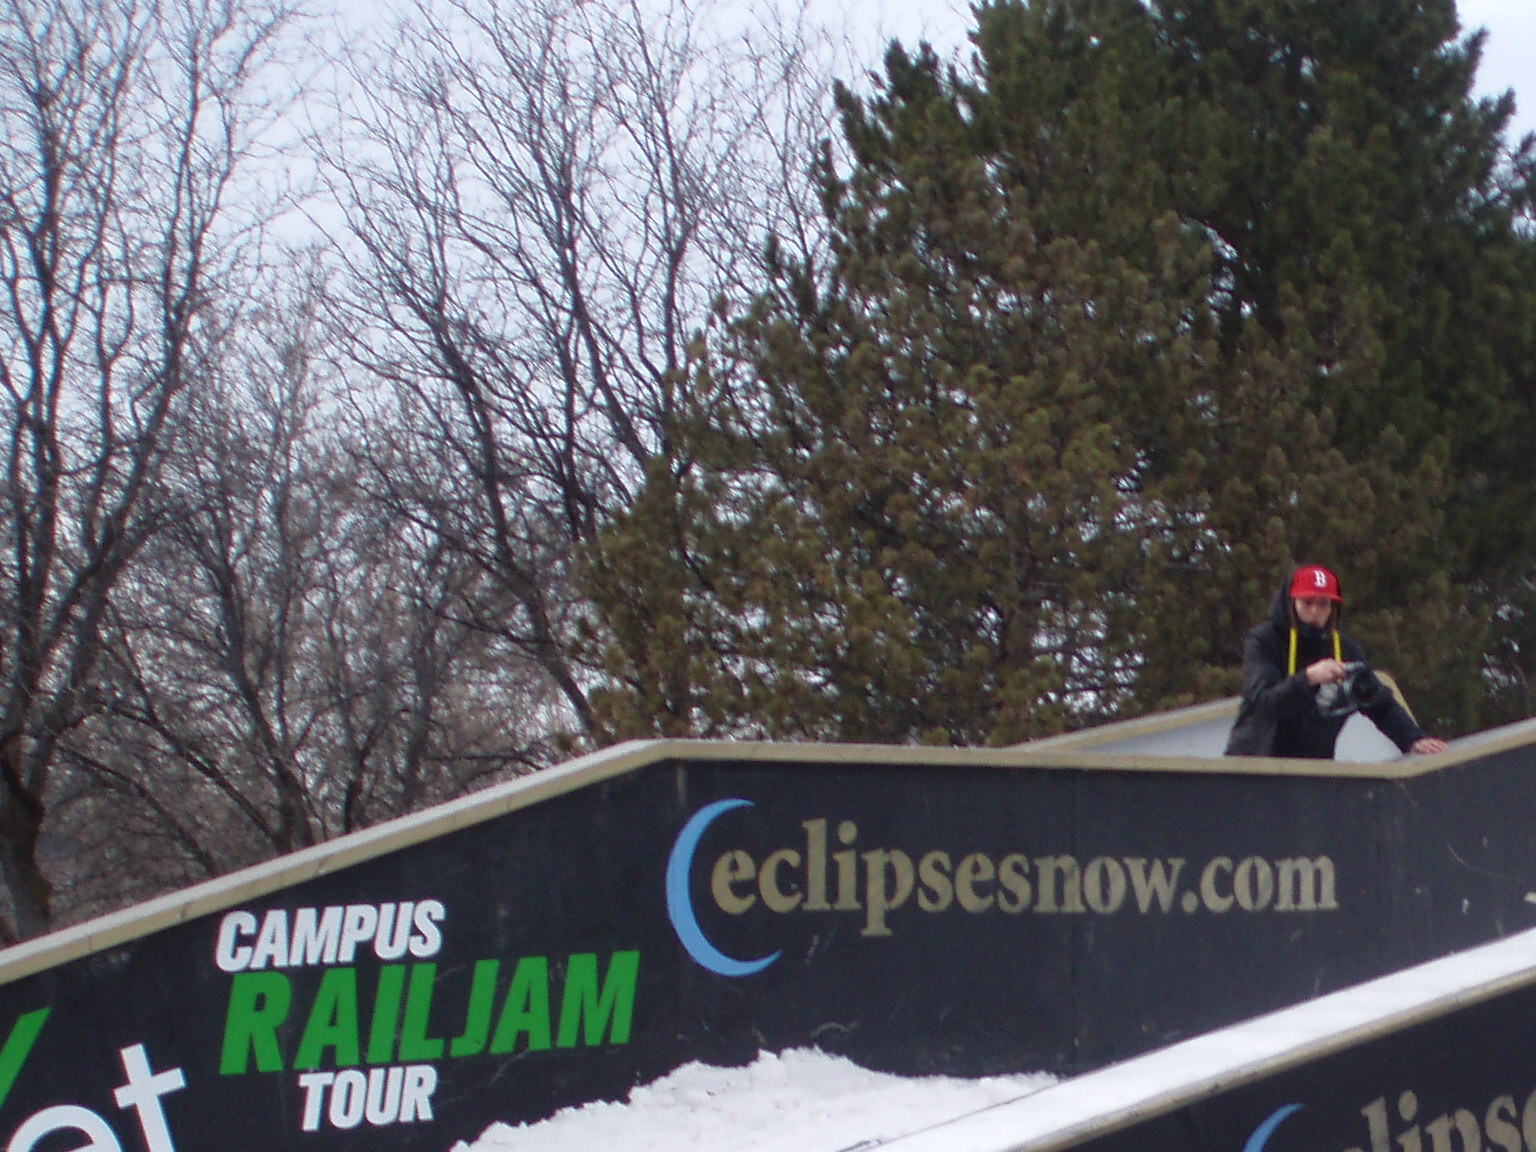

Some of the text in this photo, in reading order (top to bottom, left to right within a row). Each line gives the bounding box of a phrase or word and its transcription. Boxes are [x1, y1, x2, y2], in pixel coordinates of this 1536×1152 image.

[1313, 569, 1328, 588] B
[710, 816, 1340, 937] eclipsesnow.com
[215, 899, 446, 972] CAMPUS
[218, 949, 641, 1076] RAILJAM
[299, 1065, 438, 1131] TOUR
